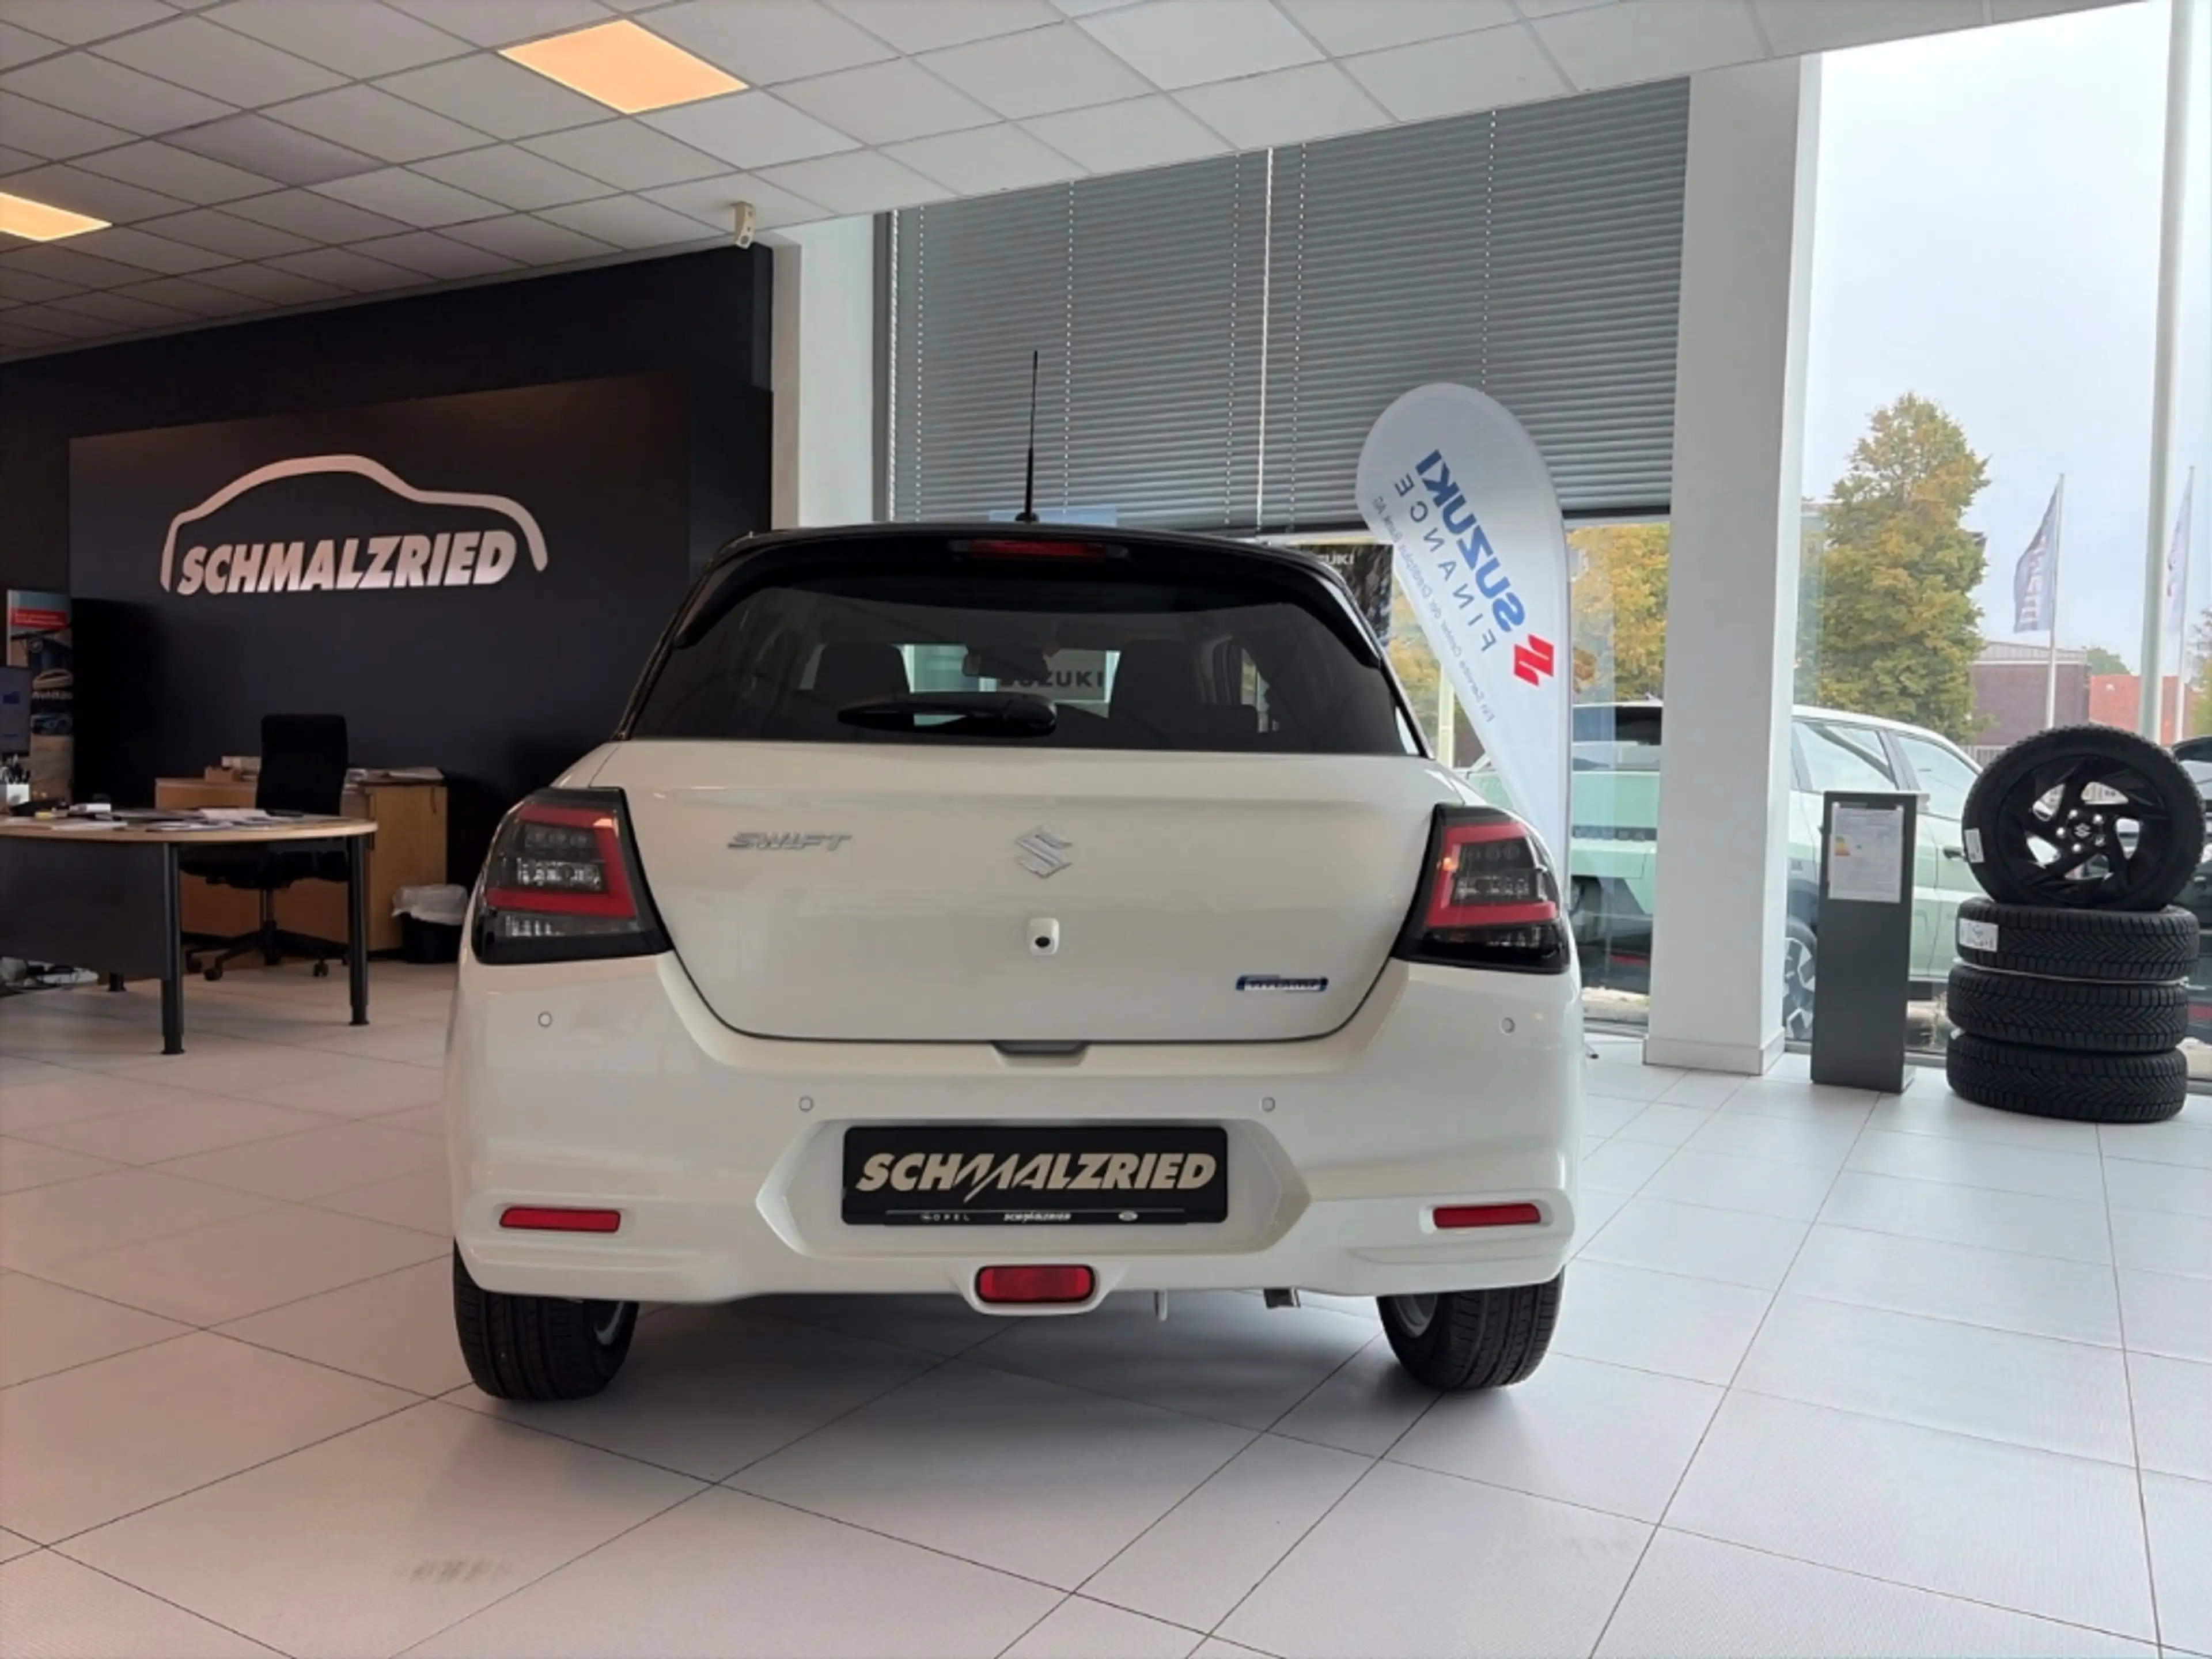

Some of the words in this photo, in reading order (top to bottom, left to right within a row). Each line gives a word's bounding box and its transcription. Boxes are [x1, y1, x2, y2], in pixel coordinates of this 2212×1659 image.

[177, 529, 517, 596] SCHMALZRIED
[726, 832, 853, 851] SWIFT
[855, 1153, 1217, 1203] SCHMALZRIED
